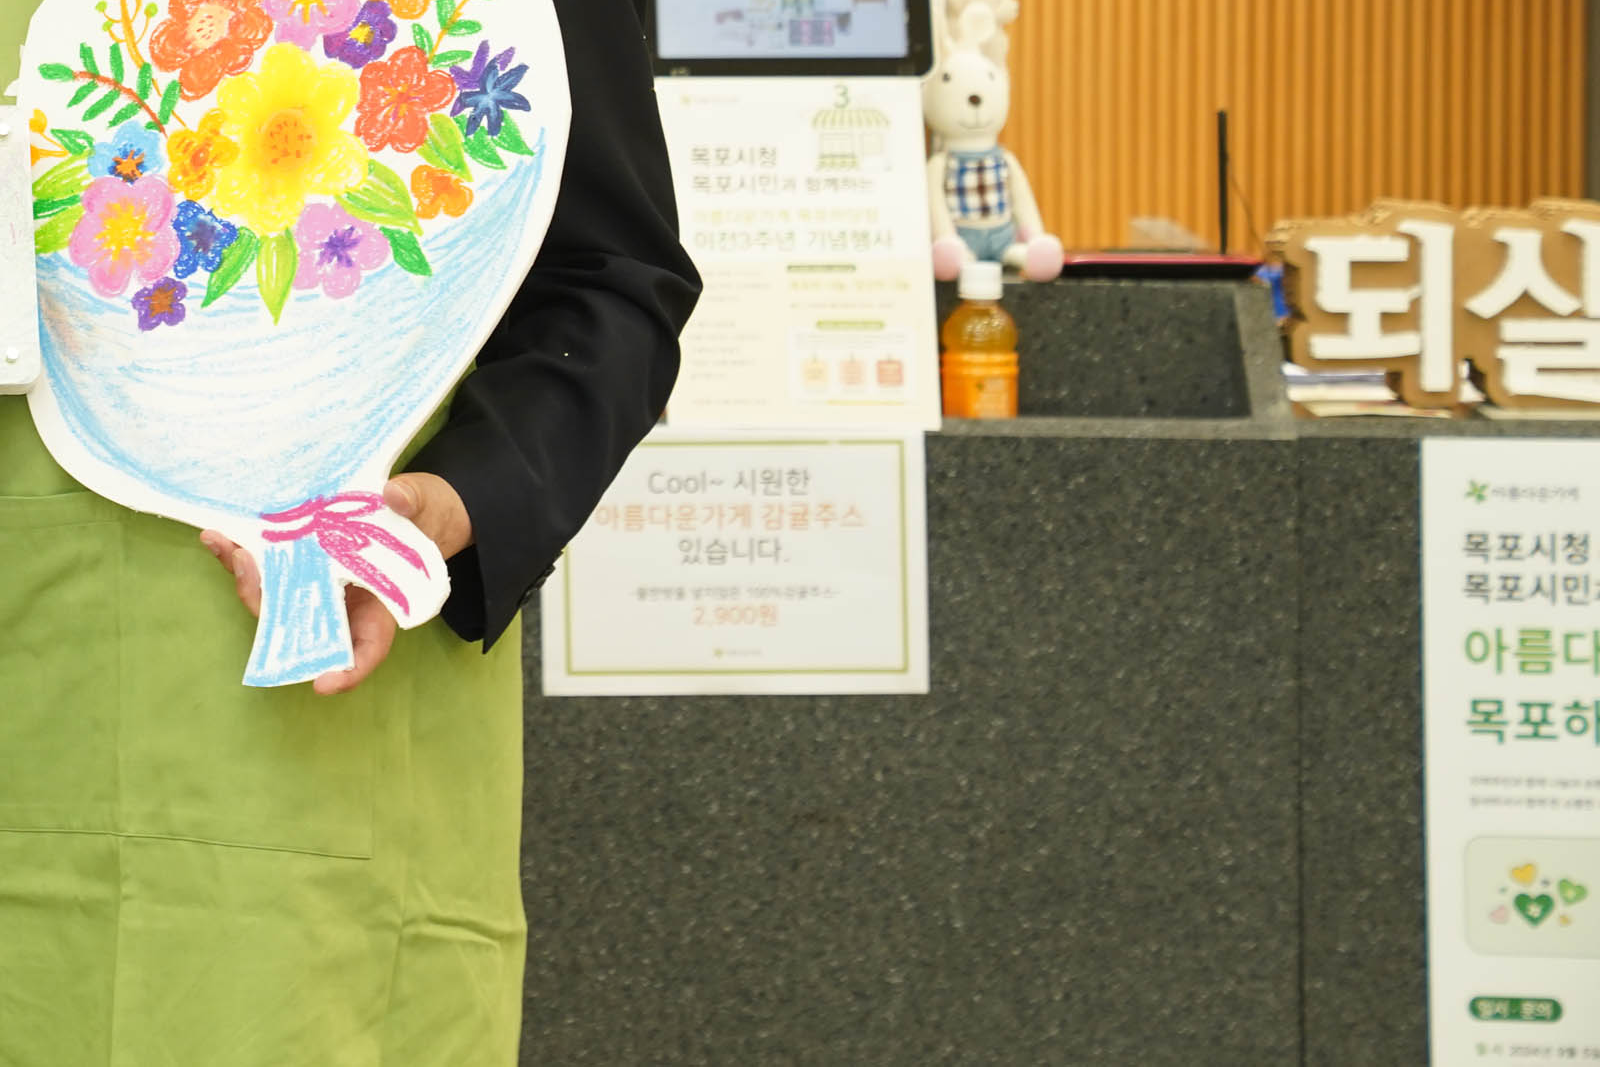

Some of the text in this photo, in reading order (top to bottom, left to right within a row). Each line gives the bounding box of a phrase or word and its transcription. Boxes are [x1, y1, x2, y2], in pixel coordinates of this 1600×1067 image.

[647, 469, 810, 496] Cool~ 시원한
[595, 504, 864, 532] 아름다운가게 감귤주스
[678, 538, 791, 565] 있습니다.
[1463, 533, 1590, 565] 목포시청
[1463, 574, 1600, 606] 목포시민
